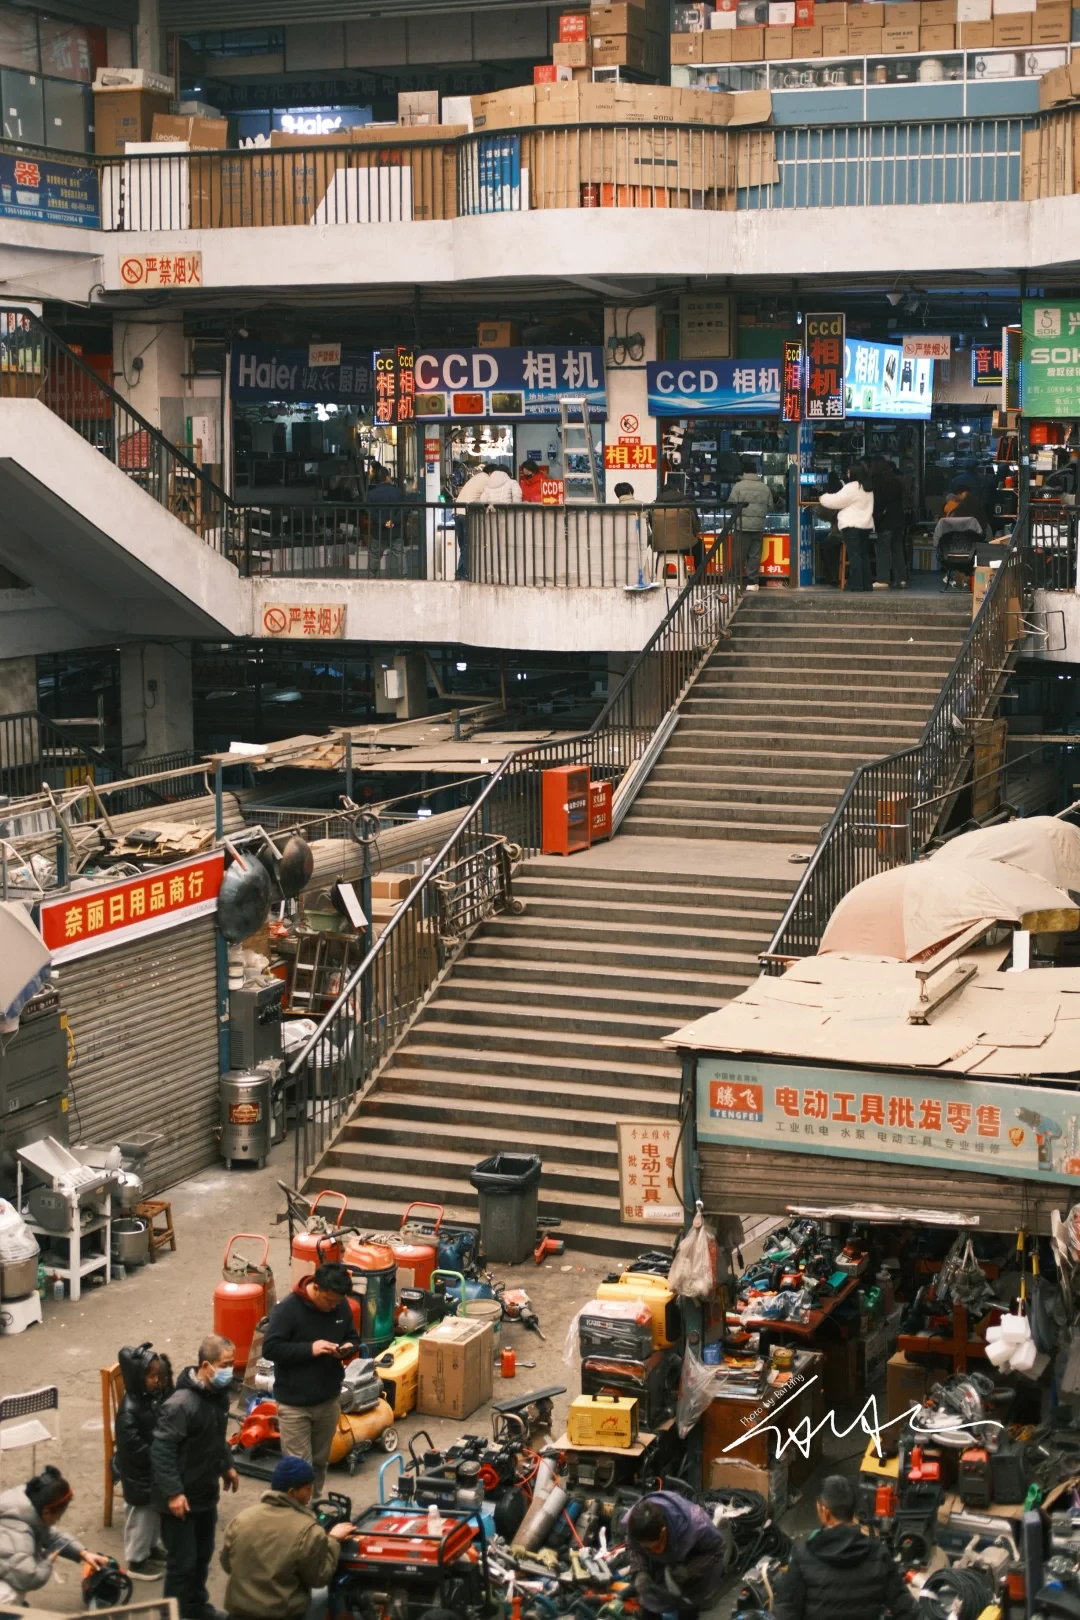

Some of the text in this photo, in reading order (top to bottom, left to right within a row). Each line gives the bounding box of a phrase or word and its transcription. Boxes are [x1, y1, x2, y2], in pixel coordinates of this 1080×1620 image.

[155, 132, 181, 142] Leader
[287, 113, 342, 135] Haier
[14, 160, 42, 188] 器
[145, 256, 201, 286] 严禁烟火
[1036, 328, 1058, 336] SOK
[914, 342, 949, 356] 严禁烟火
[238, 354, 298, 391] Haier
[338, 365, 376, 393] 厨房
[415, 350, 599, 390] CCD 相机
[808, 316, 843, 417] ccd 相机 监控
[855, 345, 880, 384] 相机
[399, 352, 415, 421] ccd 相机
[656, 367, 782, 395] CCD 相机
[785, 362, 801, 418] 相机
[605, 445, 656, 464] 相机
[542, 481, 558, 495] CCD
[800, 474, 816, 483] 相机
[287, 607, 344, 636] 严禁烟火
[65, 870, 205, 938] 奈丽日用品商行
[716, 1086, 758, 1109] 腾飞
[714, 1109, 759, 1121] TENGFEI
[774, 1086, 1001, 1138] 电动工具批发零售
[630, 1129, 671, 1140] 专业维修
[775, 1121, 1000, 1154] 工业机电 水泵 电动工具 专业维修
[628, 1154, 638, 1186] 批发
[641, 1143, 661, 1204] 电动工具
[624, 1204, 644, 1218] 电话
